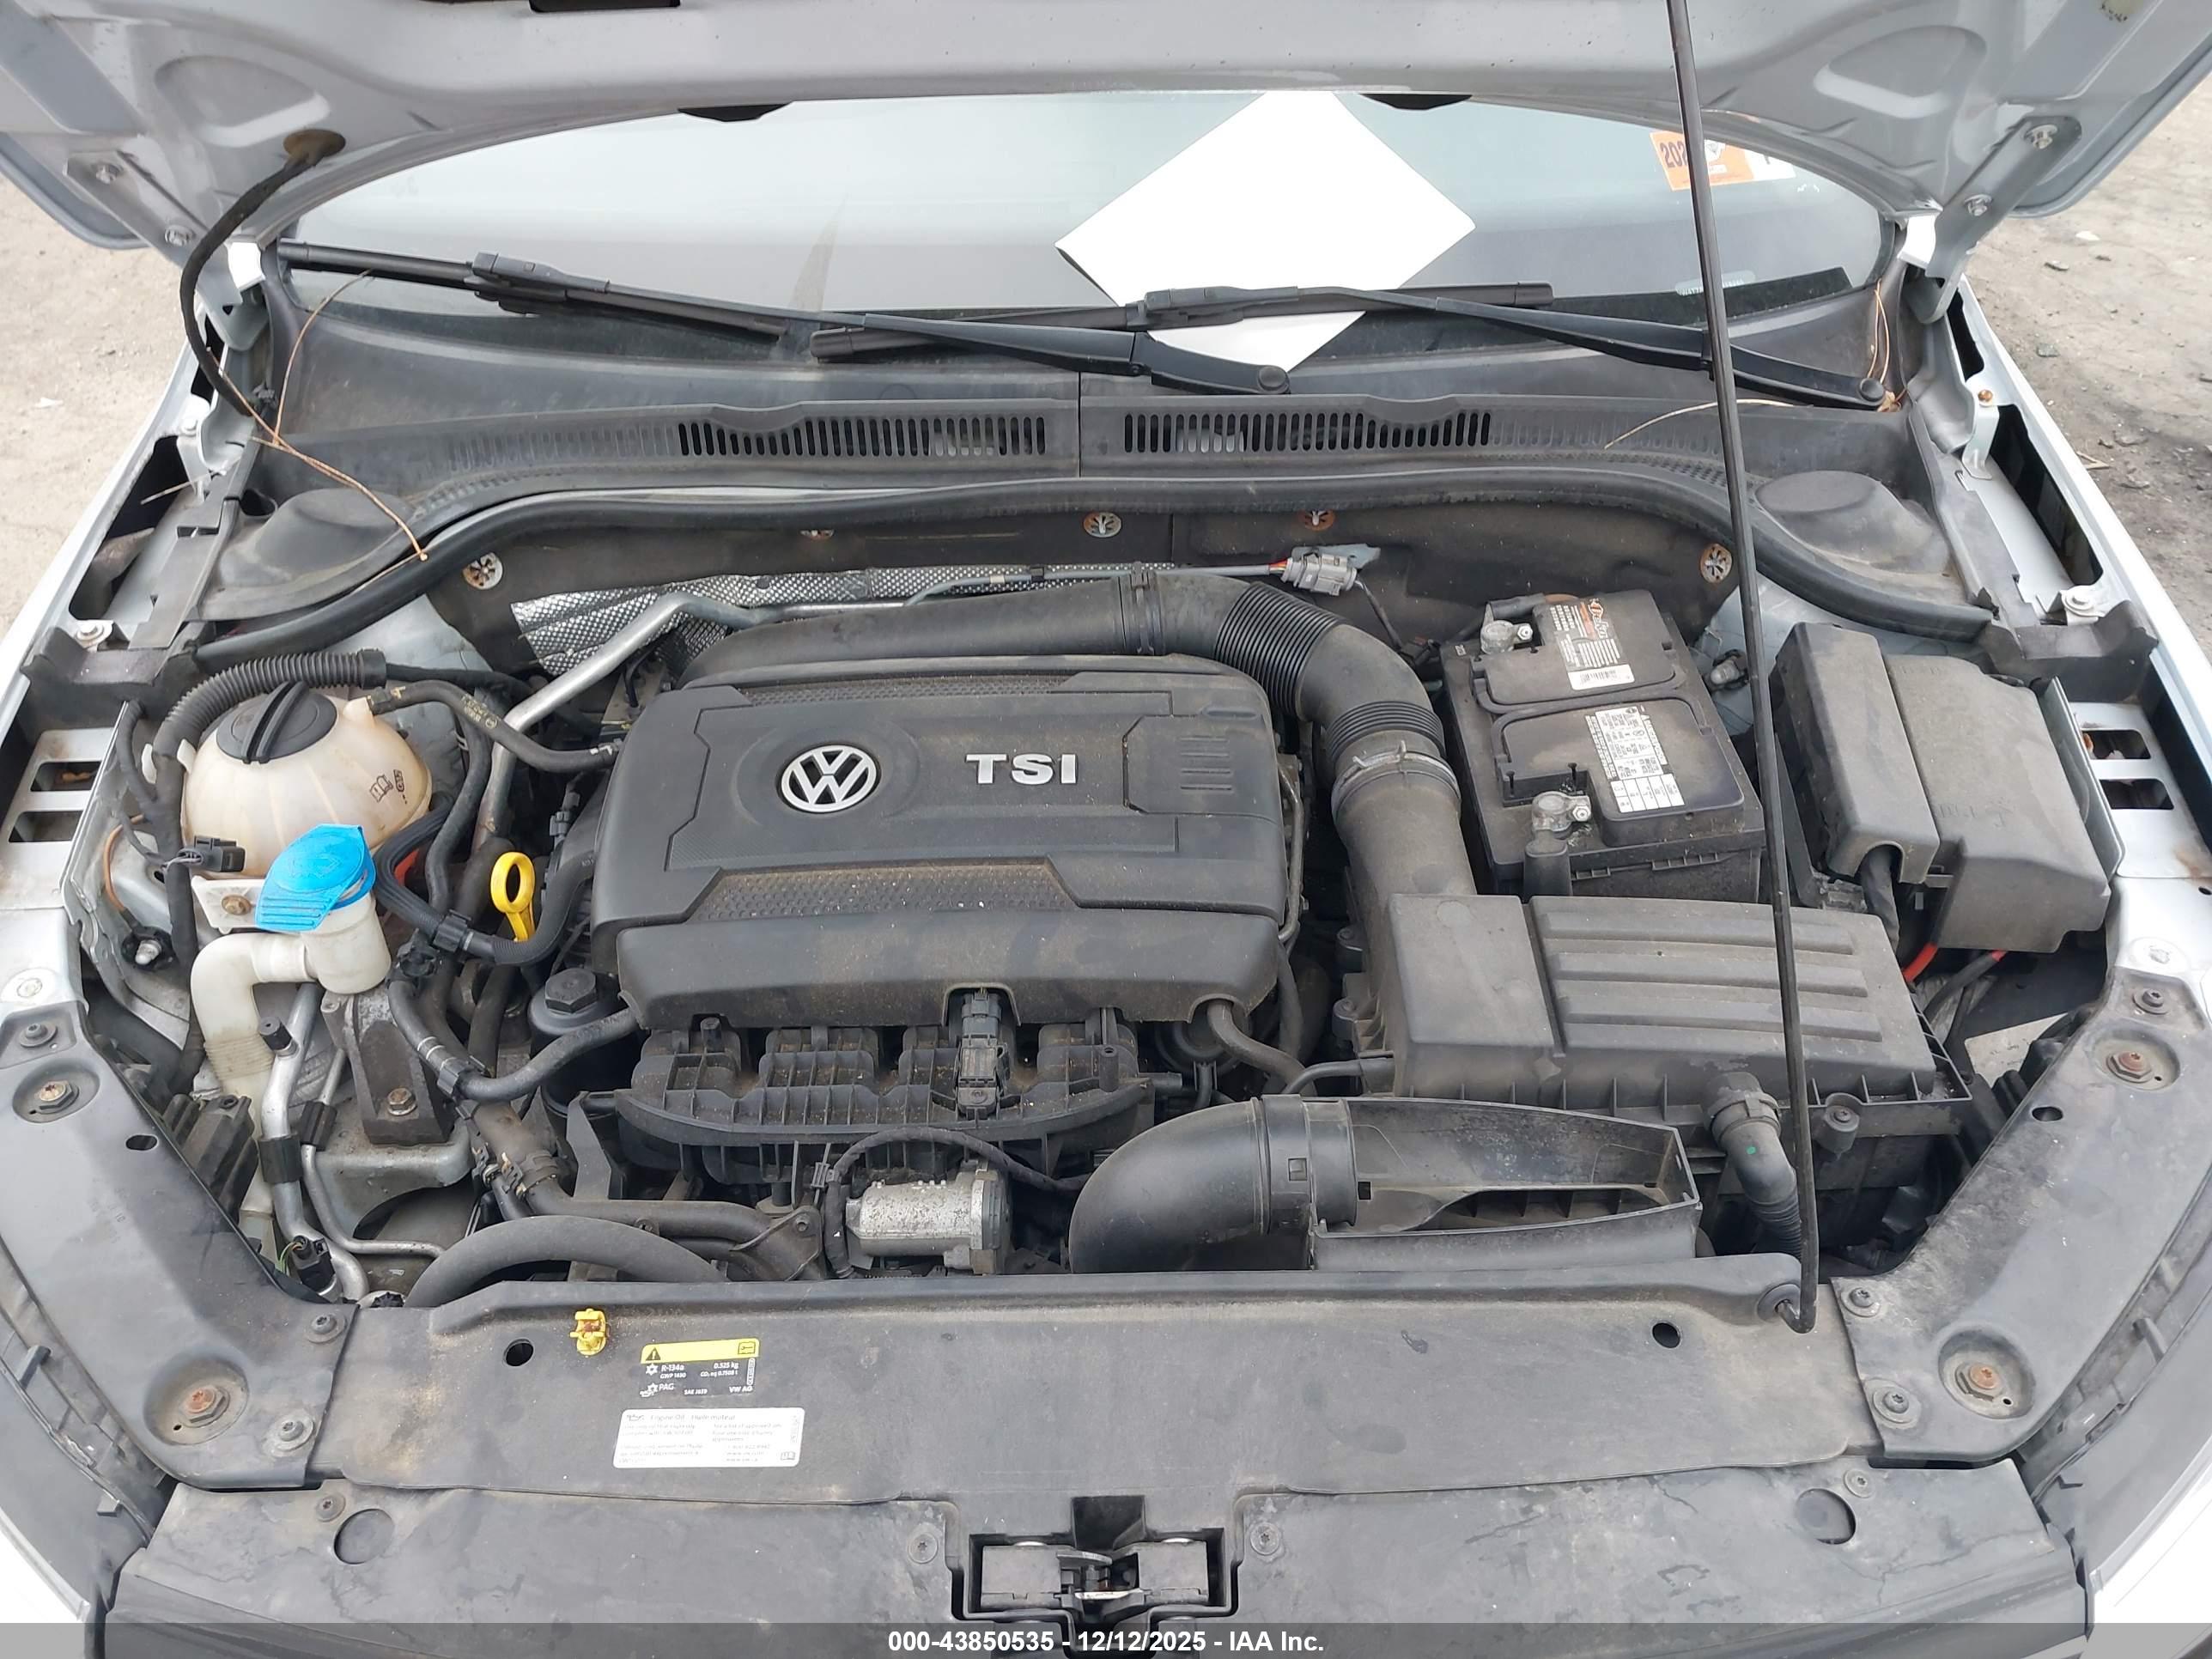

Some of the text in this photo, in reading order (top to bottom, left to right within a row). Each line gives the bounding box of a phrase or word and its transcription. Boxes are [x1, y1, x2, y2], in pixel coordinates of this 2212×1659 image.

[965, 753, 1077, 785] TSI
[660, 1364, 685, 1372] R-134a
[731, 1361, 739, 1370] kg
[659, 1382, 675, 1391] PAG
